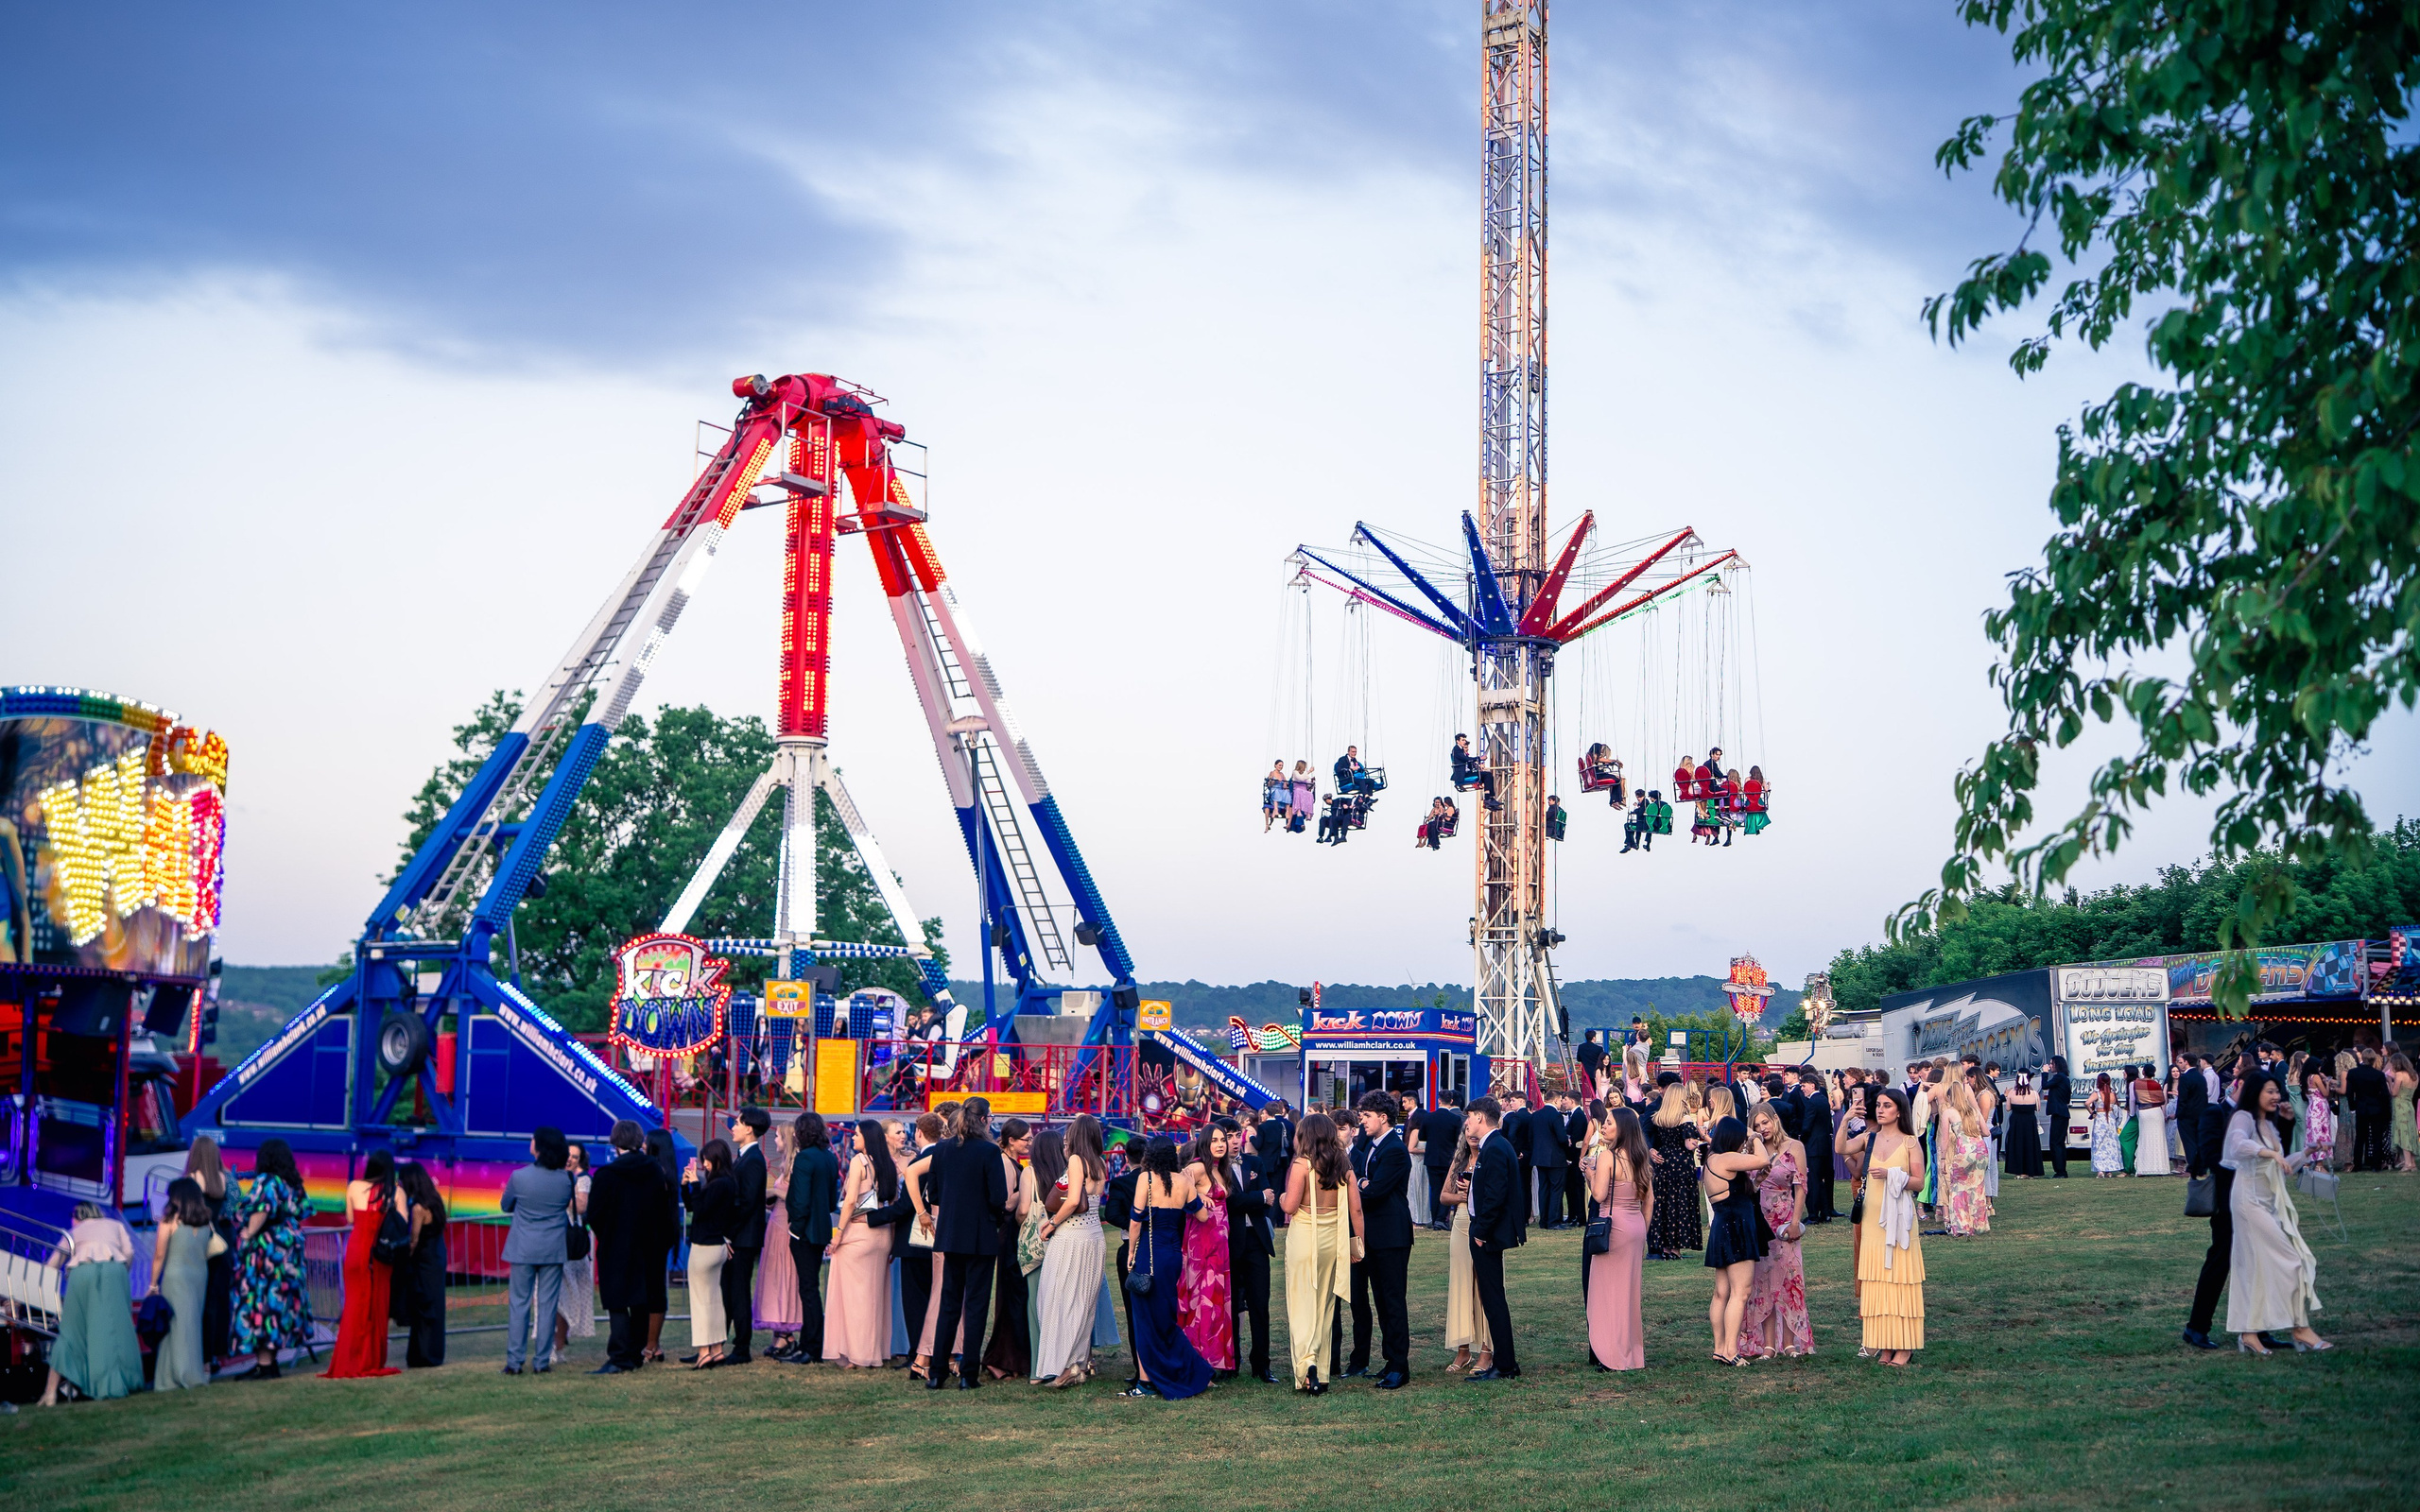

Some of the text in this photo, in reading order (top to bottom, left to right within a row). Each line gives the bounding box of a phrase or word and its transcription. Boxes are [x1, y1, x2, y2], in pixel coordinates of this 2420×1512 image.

[2066, 969, 2163, 1000] DODGEMS
[2193, 955, 2306, 993] DOEMS
[776, 1001, 799, 1013] EXIT
[2069, 1005, 2155, 1023] LONG LOAD
[616, 997, 717, 1050] DOWN
[1142, 1016, 1168, 1027] ENTRANCE
[1372, 1010, 1425, 1031] DOWN
[498, 1002, 598, 1094] www.williamhclark.co.uk
[1315, 1040, 1416, 1049] www.williamhclark.co.uk
[1153, 1030, 1248, 1098] www.williamhclark.co.uk
